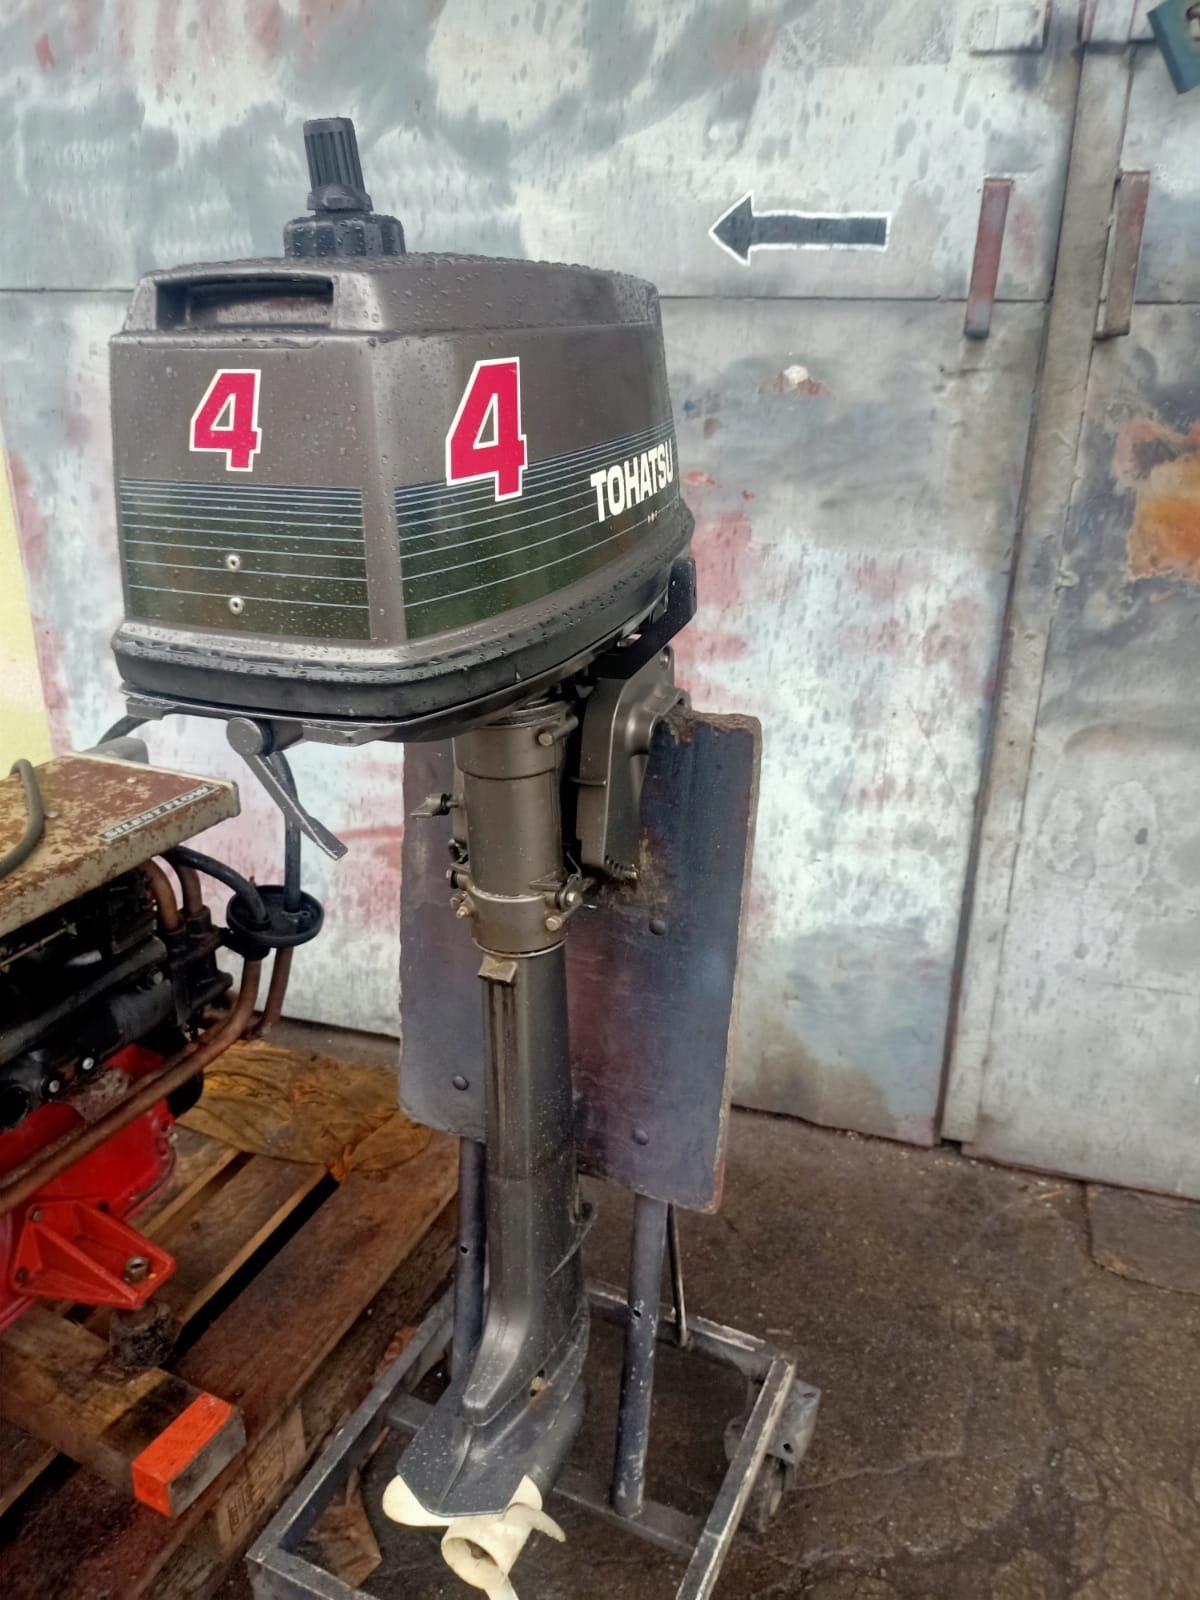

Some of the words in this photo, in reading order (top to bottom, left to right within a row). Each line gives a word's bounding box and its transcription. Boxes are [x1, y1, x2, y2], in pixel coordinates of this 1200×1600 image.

[190, 368, 262, 472] 4
[445, 357, 527, 502] 4
[590, 438, 674, 523] TOHATSU
[104, 808, 164, 839] SILENT
